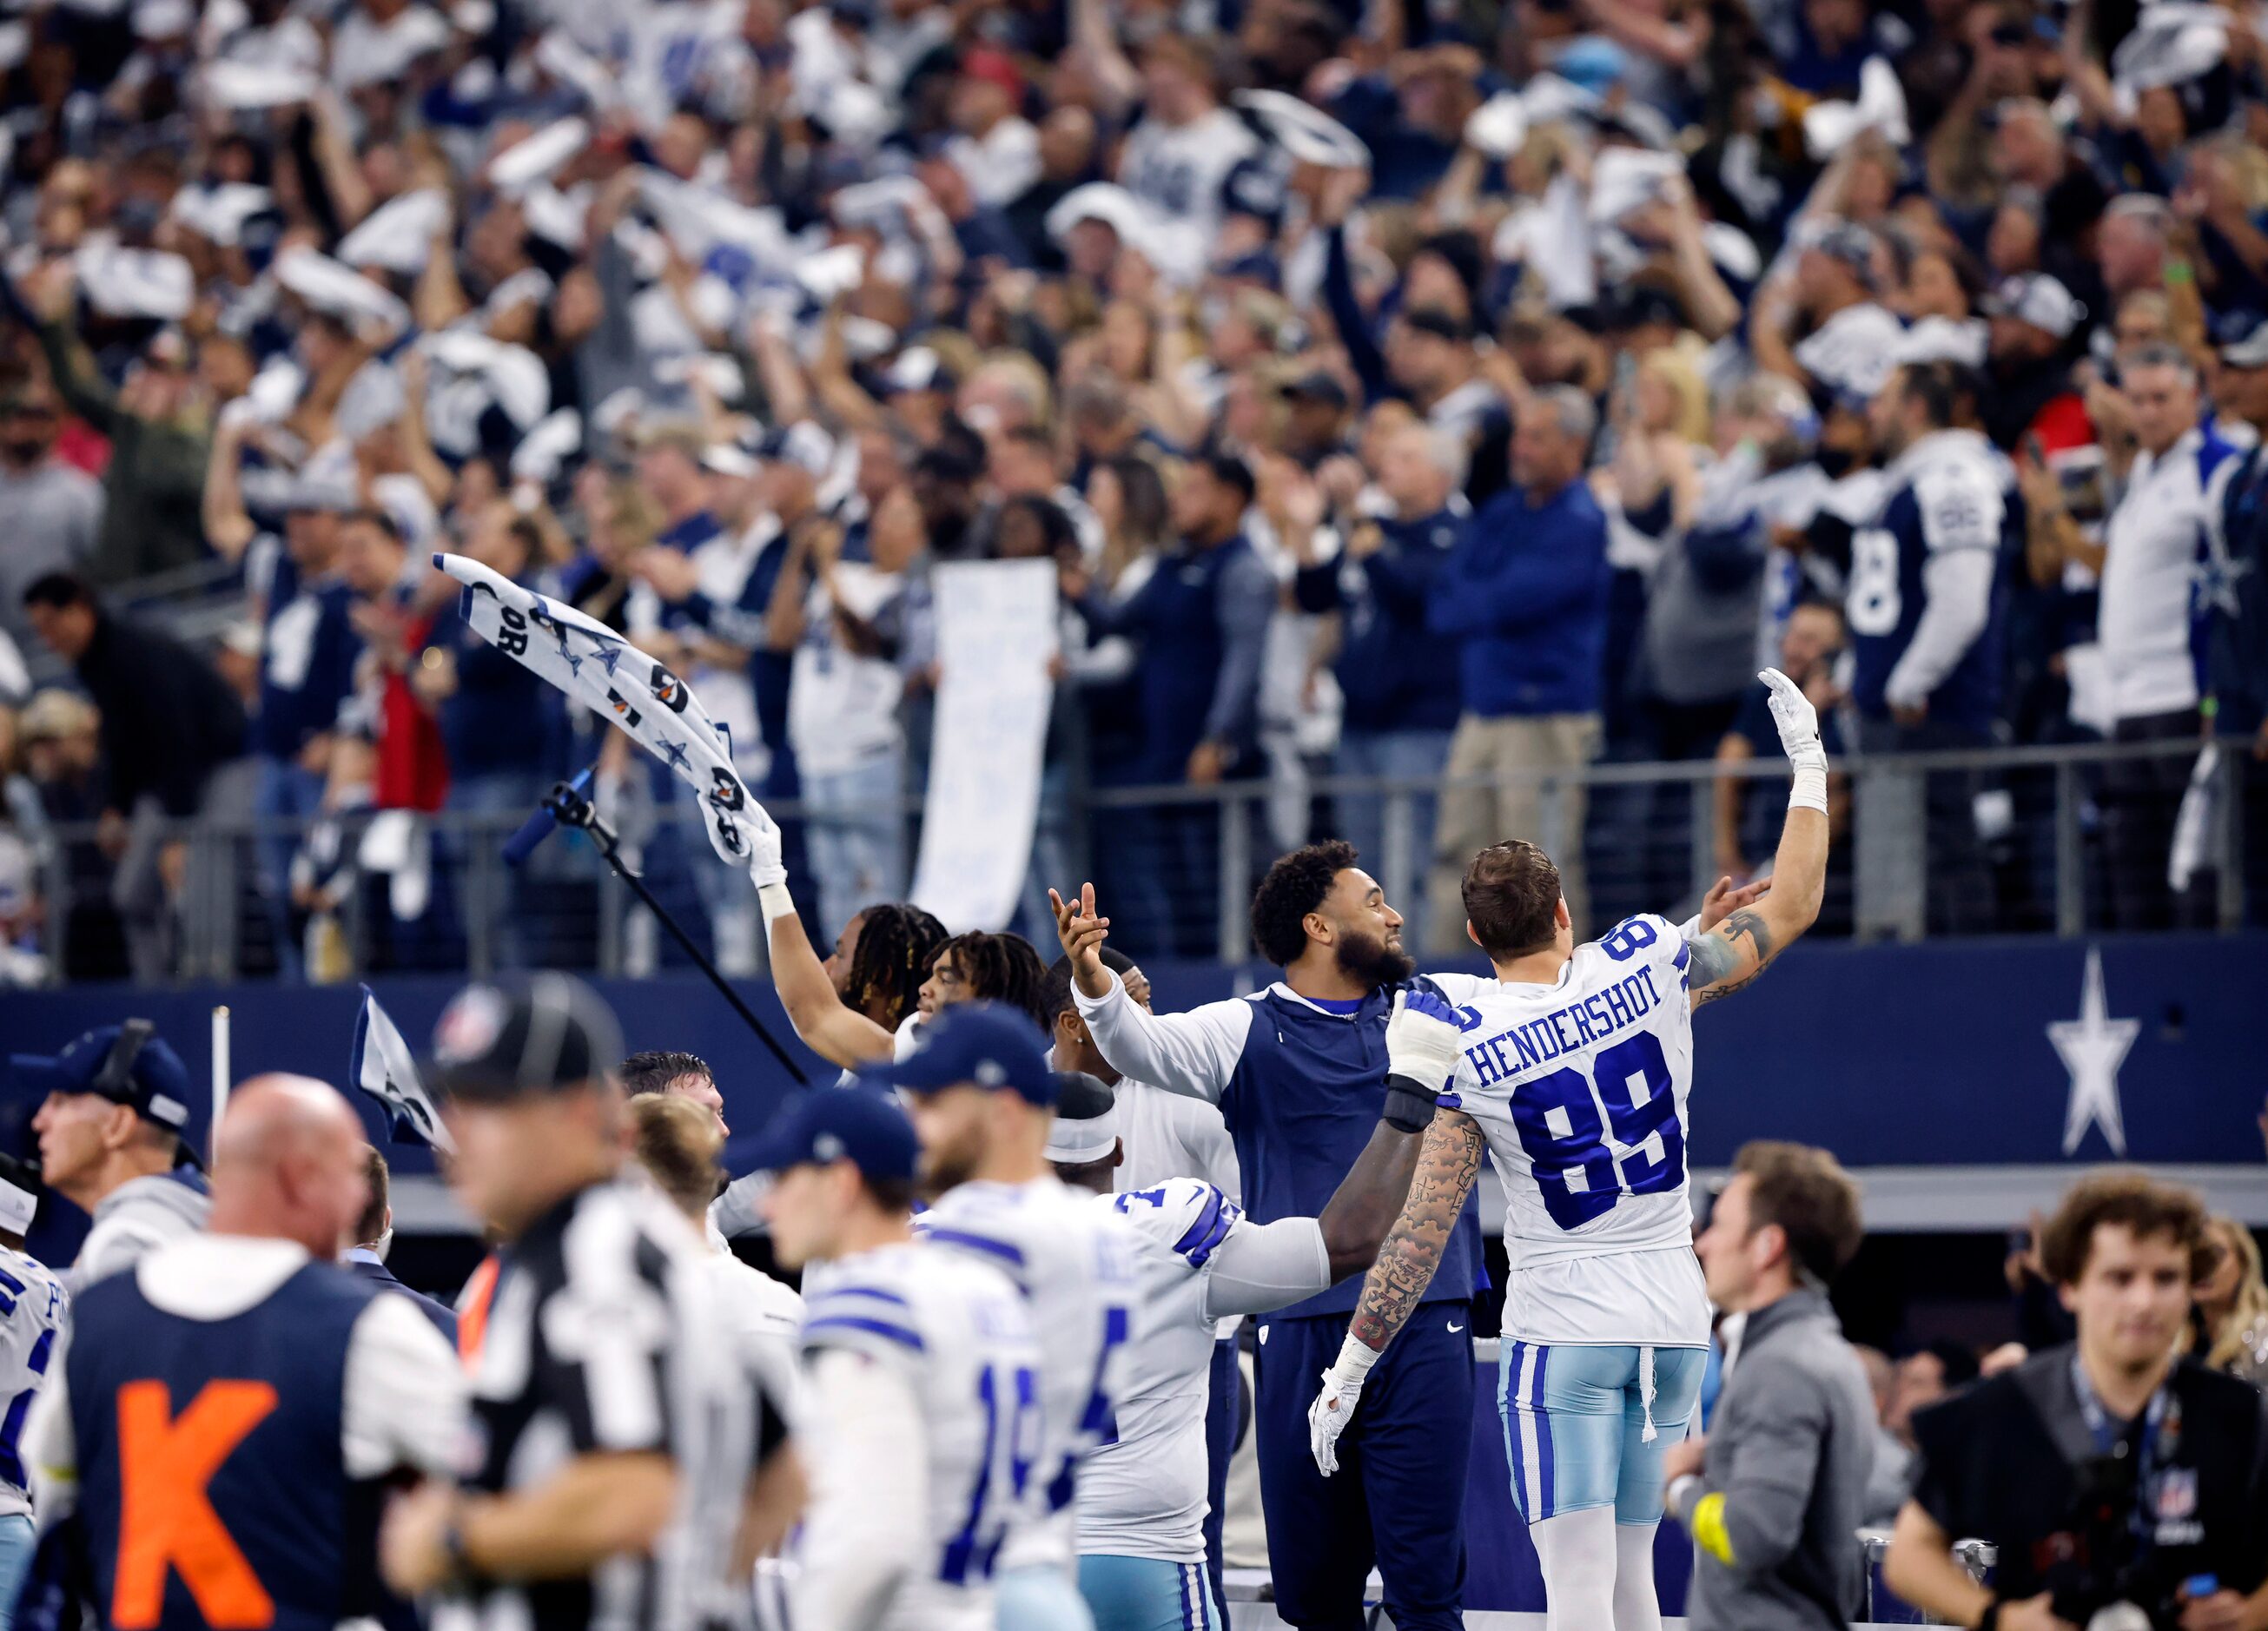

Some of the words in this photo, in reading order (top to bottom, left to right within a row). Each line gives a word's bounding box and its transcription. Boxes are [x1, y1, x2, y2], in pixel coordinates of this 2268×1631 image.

[1465, 965, 1661, 1087] HENDERSHOT
[1509, 1030, 1685, 1230] 89
[111, 1378, 279, 1629] K
